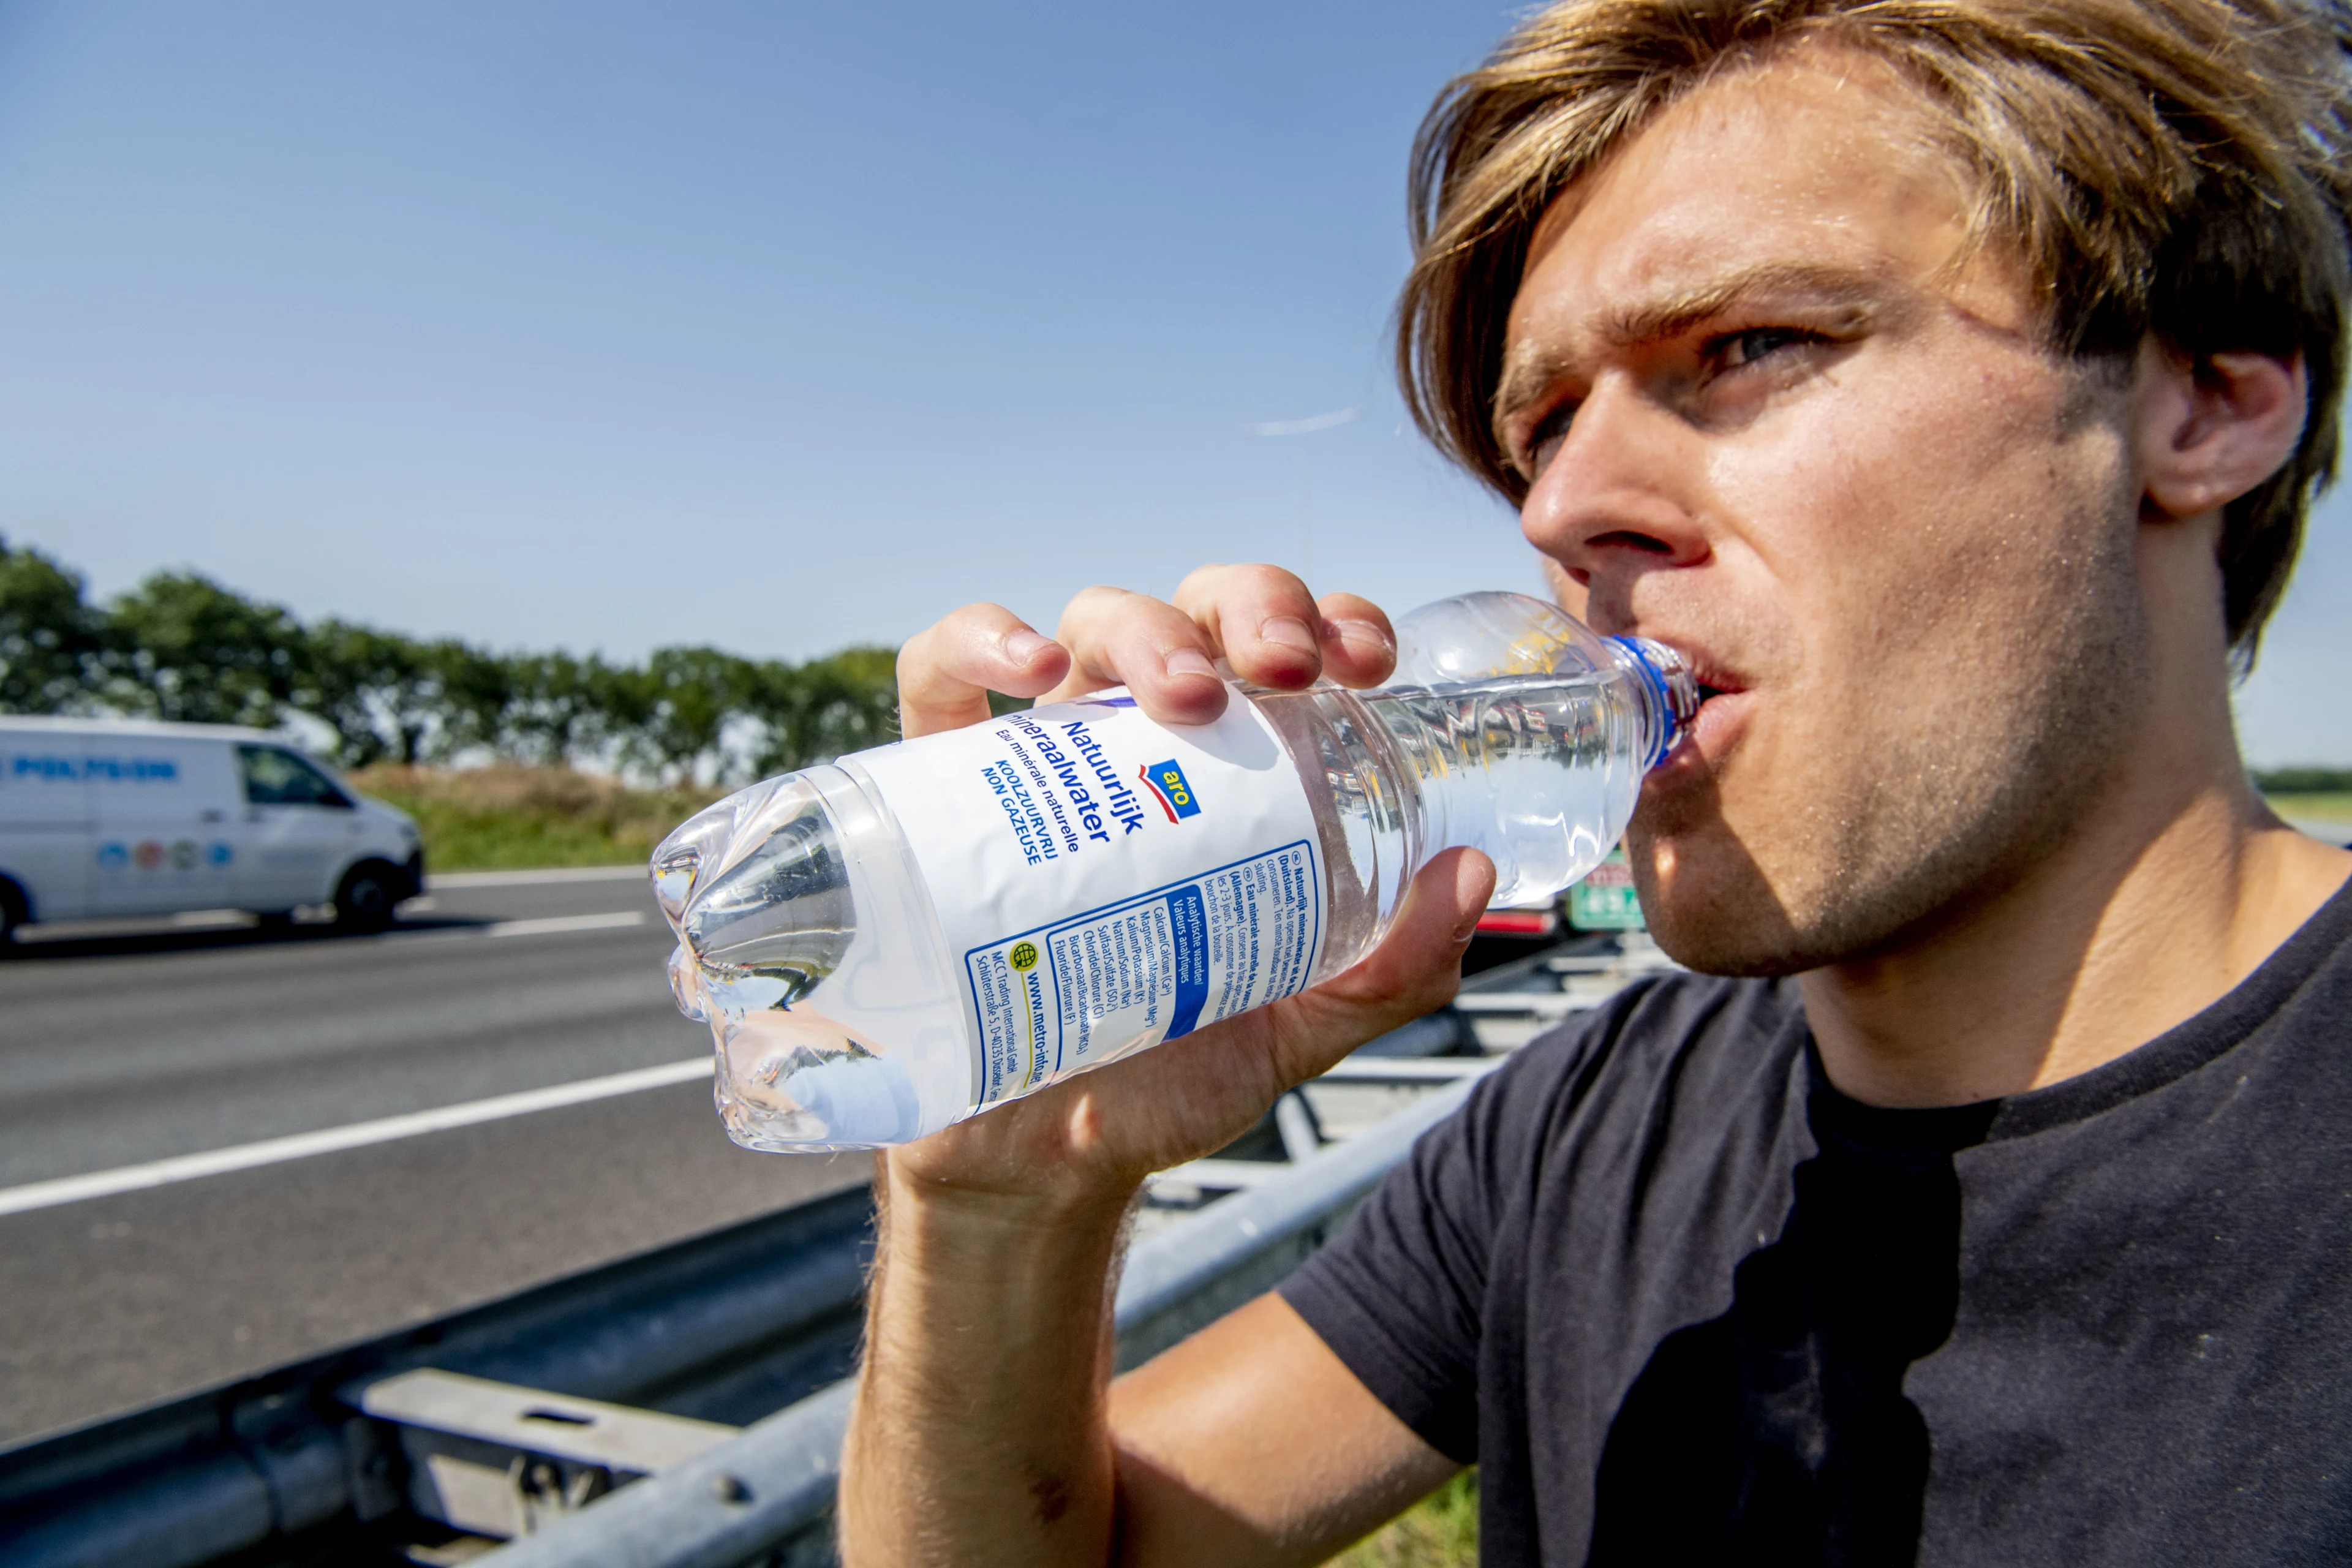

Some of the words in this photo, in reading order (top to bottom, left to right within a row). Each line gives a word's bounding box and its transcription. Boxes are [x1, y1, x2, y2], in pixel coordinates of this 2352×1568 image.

[995, 729, 1015, 742] Eau
[1009, 742, 1047, 788] minérale
[1042, 790, 1079, 853] naturelle
[999, 715, 1110, 842] mineraalwater
[1060, 722, 1144, 835] Natuurlijk
[1163, 771, 1189, 805] aro
[980, 767, 1008, 795] NON
[1001, 797, 1042, 866] GAZEUSE
[995, 760, 1058, 861] KOOLZUURVRIJ
[1204, 878, 1218, 914] bouchon
[1216, 874, 1227, 887] les
[1220, 888, 1231, 902] 2-3
[1246, 883, 1255, 901] Eau
[1254, 862, 1267, 895] sluiting.
[1267, 859, 1281, 908] consumeren.
[1278, 854, 1295, 908] (Duitsland).
[1294, 867, 1308, 912] Natuurlijk
[1220, 902, 1232, 924] jours.
[1229, 871, 1247, 927] (Allemagne).
[1274, 907, 1283, 924] Ten
[1286, 908, 1295, 920] Na
[1173, 899, 1186, 935] Valeurs
[1186, 896, 1203, 948] Analytische
[1212, 915, 1221, 925] de
[1213, 925, 1222, 933] la
[1248, 902, 1260, 939] minérale
[1284, 921, 1294, 945] openen
[1126, 915, 1145, 990] Kalium/Potassium
[1153, 907, 1172, 975] Calcium/Calcium
[1213, 933, 1223, 965] bouteille.
[1238, 927, 1248, 960] Conserver
[1275, 924, 1283, 947] minste
[1284, 944, 1294, 959] koel
[1294, 913, 1307, 965] mineraalwater
[992, 951, 1006, 973] MCC
[1084, 930, 1102, 1003] Chloride/Chlorure
[1098, 925, 1116, 988] Sulfaat/Sulfate
[1112, 920, 1130, 990] Natrium/Sodium
[1140, 911, 1159, 1006] Magnesium/Magnésium
[1178, 937, 1191, 984] analytiques
[1194, 948, 1205, 986] waarden/
[1238, 960, 1246, 970] au
[1250, 940, 1259, 973] naturelle
[1270, 946, 1283, 975] houdbaar
[976, 956, 999, 1017] Schlüterstraße
[997, 973, 1011, 1008] Trading
[1054, 939, 1072, 1012] Fluoride/Fluorure
[1069, 934, 1090, 1034] Bicarbonaat/Bicarbonate
[1226, 971, 1236, 980] de
[1237, 970, 1247, 983] frais
[1248, 973, 1257, 982] de
[1240, 989, 1252, 1008] source
[988, 1017, 1000, 1027] 5,
[1003, 1006, 1017, 1054] International
[1027, 971, 1049, 1084] www.metro-info.net
[990, 1026, 1003, 1058] D-40235
[1007, 1054, 1018, 1074] GmbH
